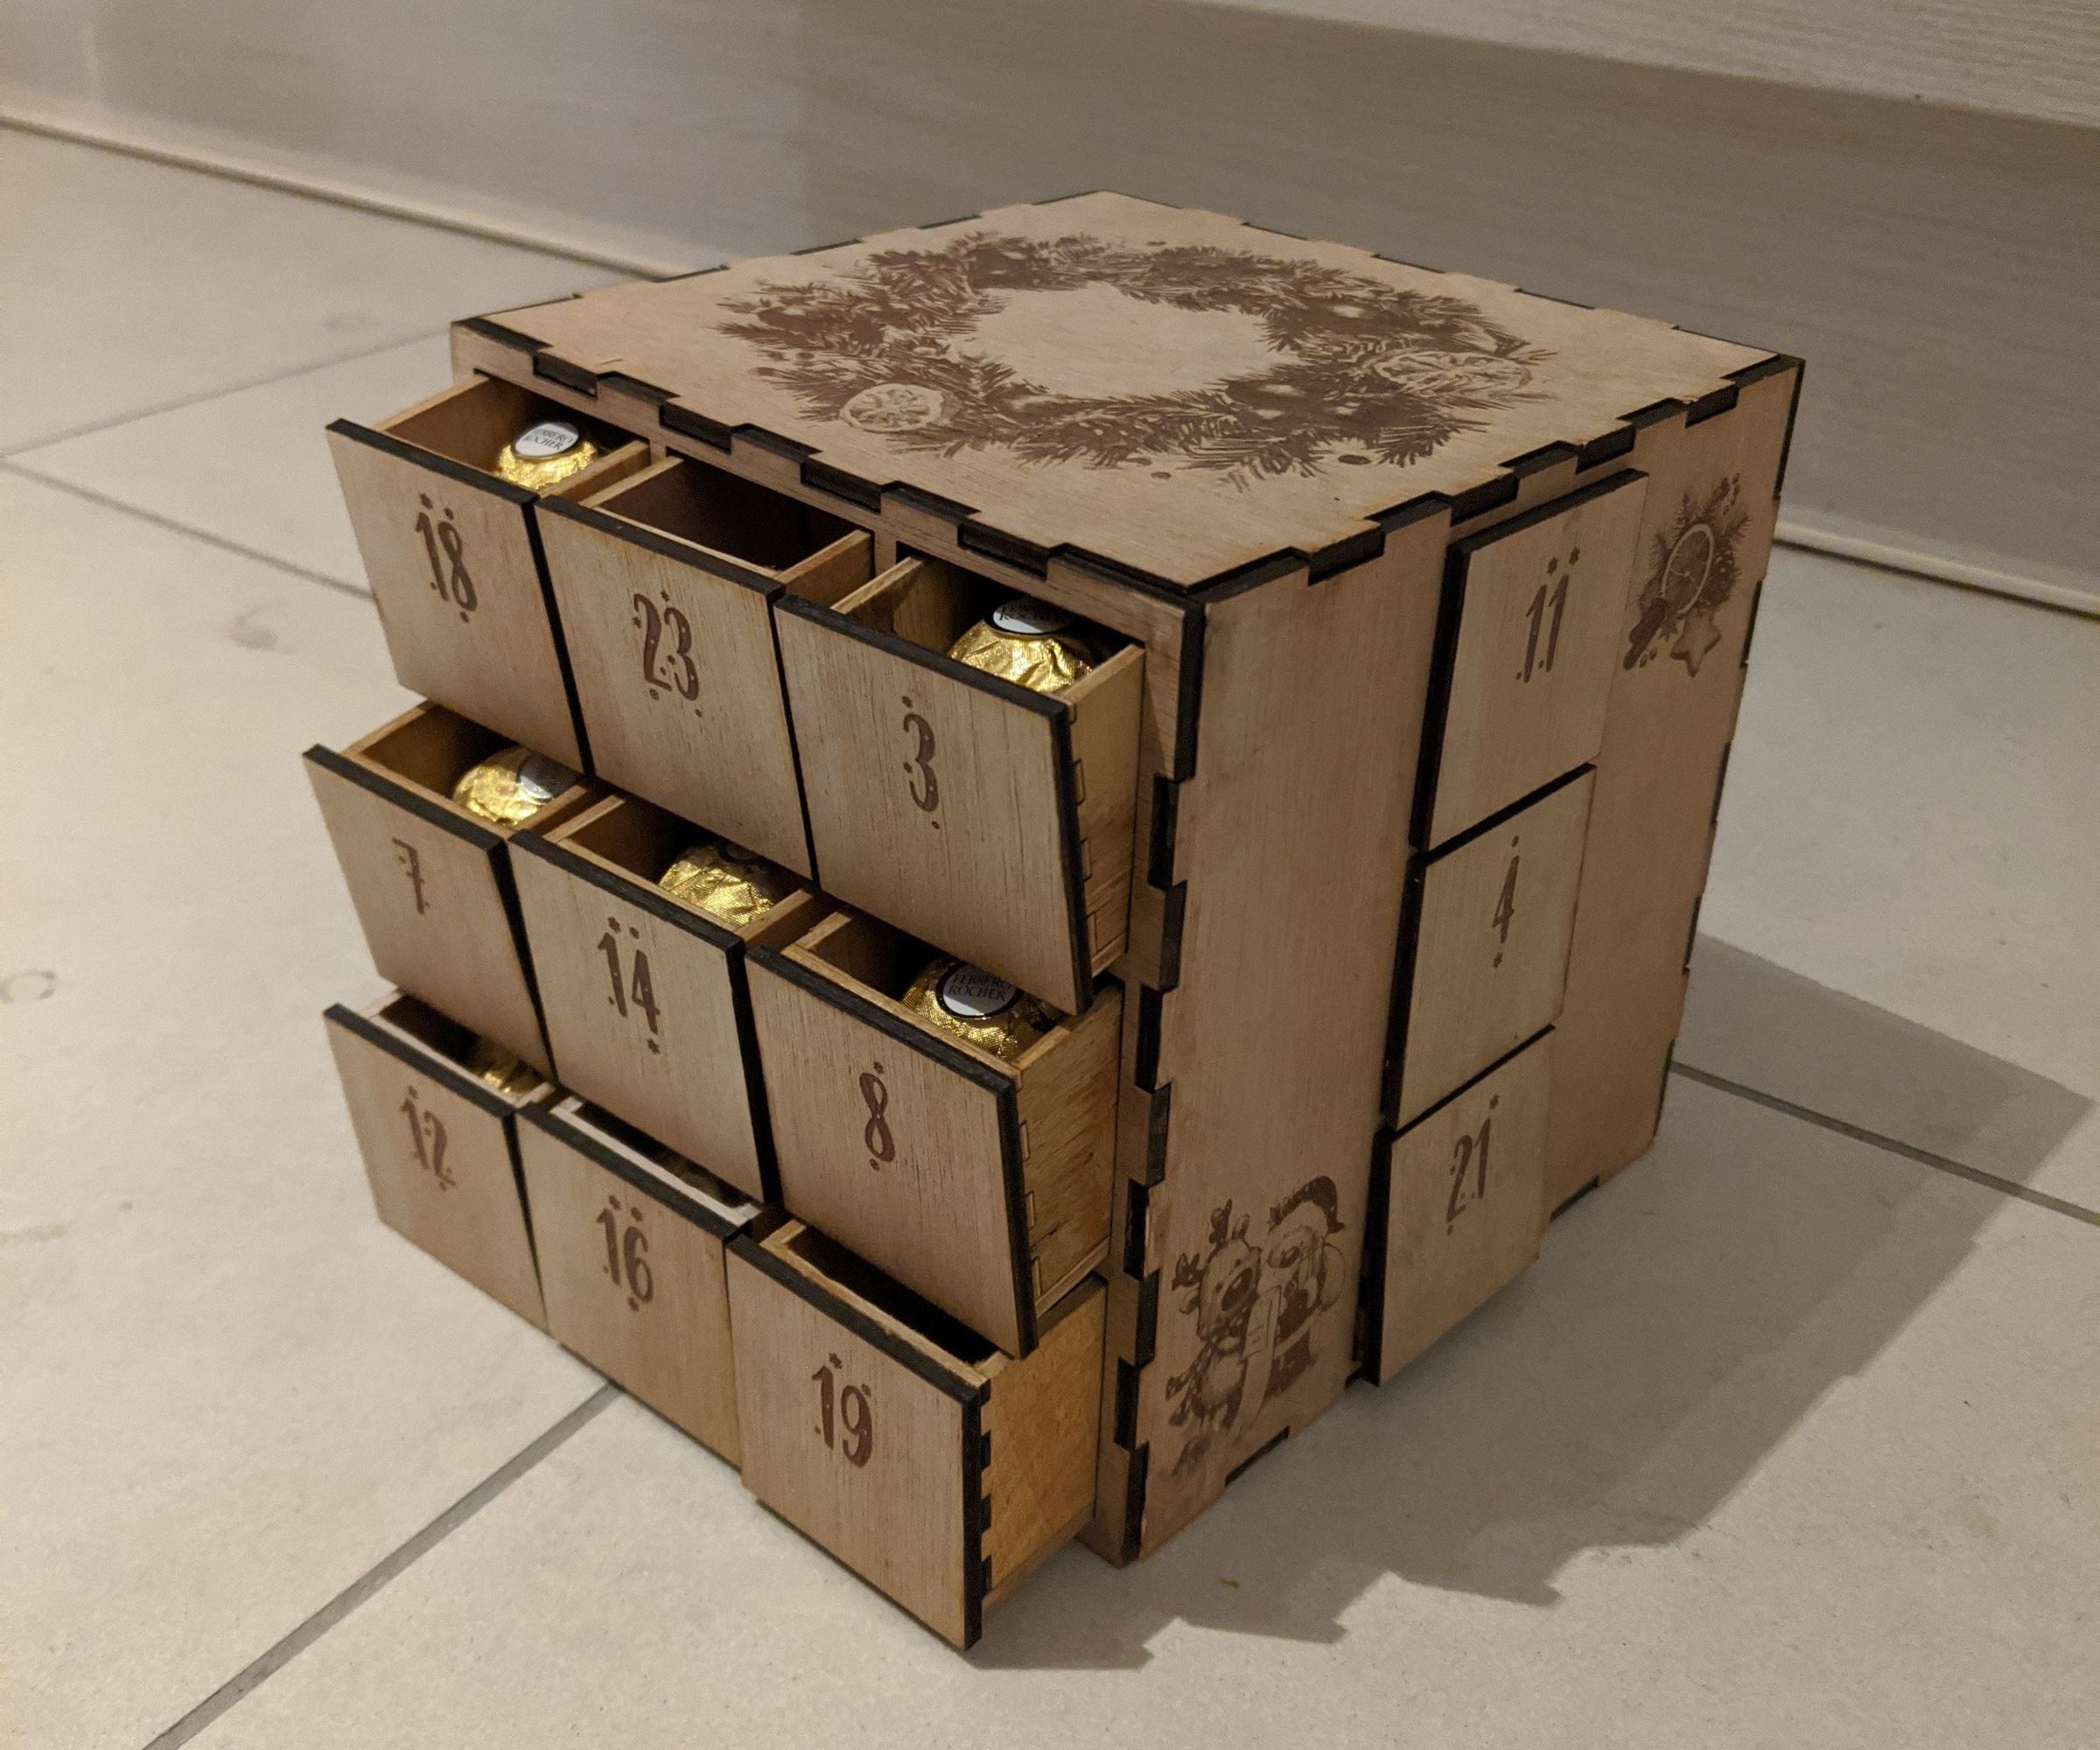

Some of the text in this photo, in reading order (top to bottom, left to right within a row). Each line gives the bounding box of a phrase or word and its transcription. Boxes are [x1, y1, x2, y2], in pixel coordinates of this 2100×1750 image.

[415, 512, 478, 612] 18
[633, 593, 700, 703] 23
[1524, 574, 1569, 684] 11
[904, 713, 940, 813] 3
[391, 837, 427, 914] 7
[1491, 855, 1520, 944] 4
[598, 930, 662, 1035] 14
[401, 1097, 456, 1187] 12
[858, 1072, 896, 1164] 8
[1446, 1116, 1491, 1223] 21
[596, 1208, 654, 1306] 16
[811, 1365, 873, 1469] 19
